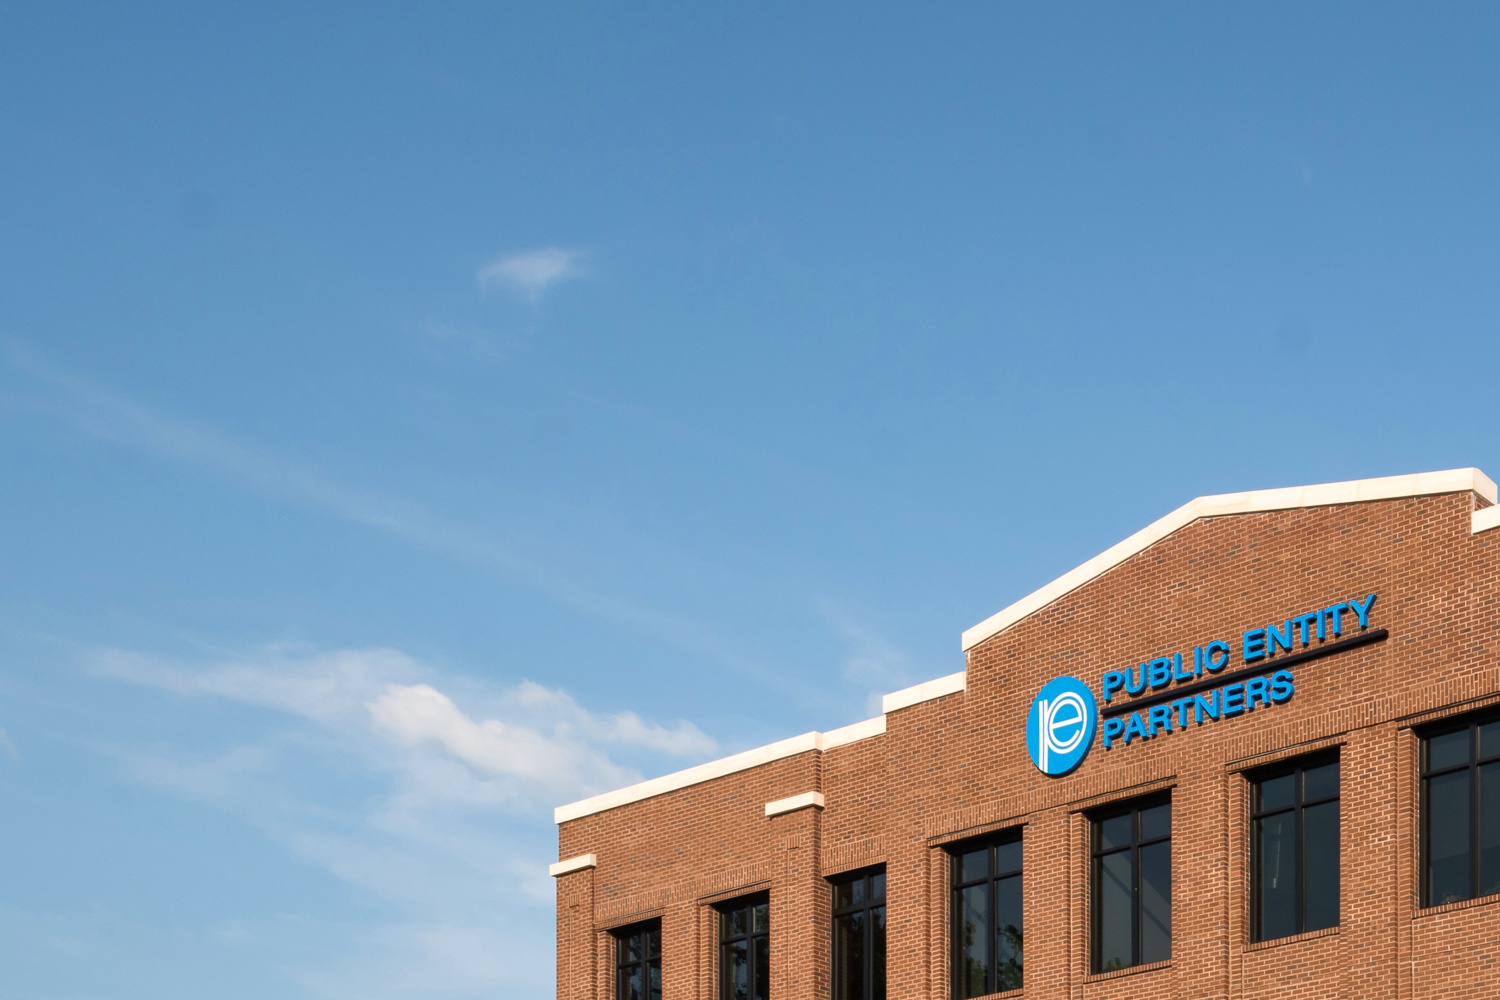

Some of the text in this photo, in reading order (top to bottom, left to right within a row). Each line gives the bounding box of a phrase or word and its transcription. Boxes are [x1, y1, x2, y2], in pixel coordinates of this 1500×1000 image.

[1103, 593, 1378, 701] PUBLIC ENTITY
[1103, 670, 1295, 748] PARTNERS
